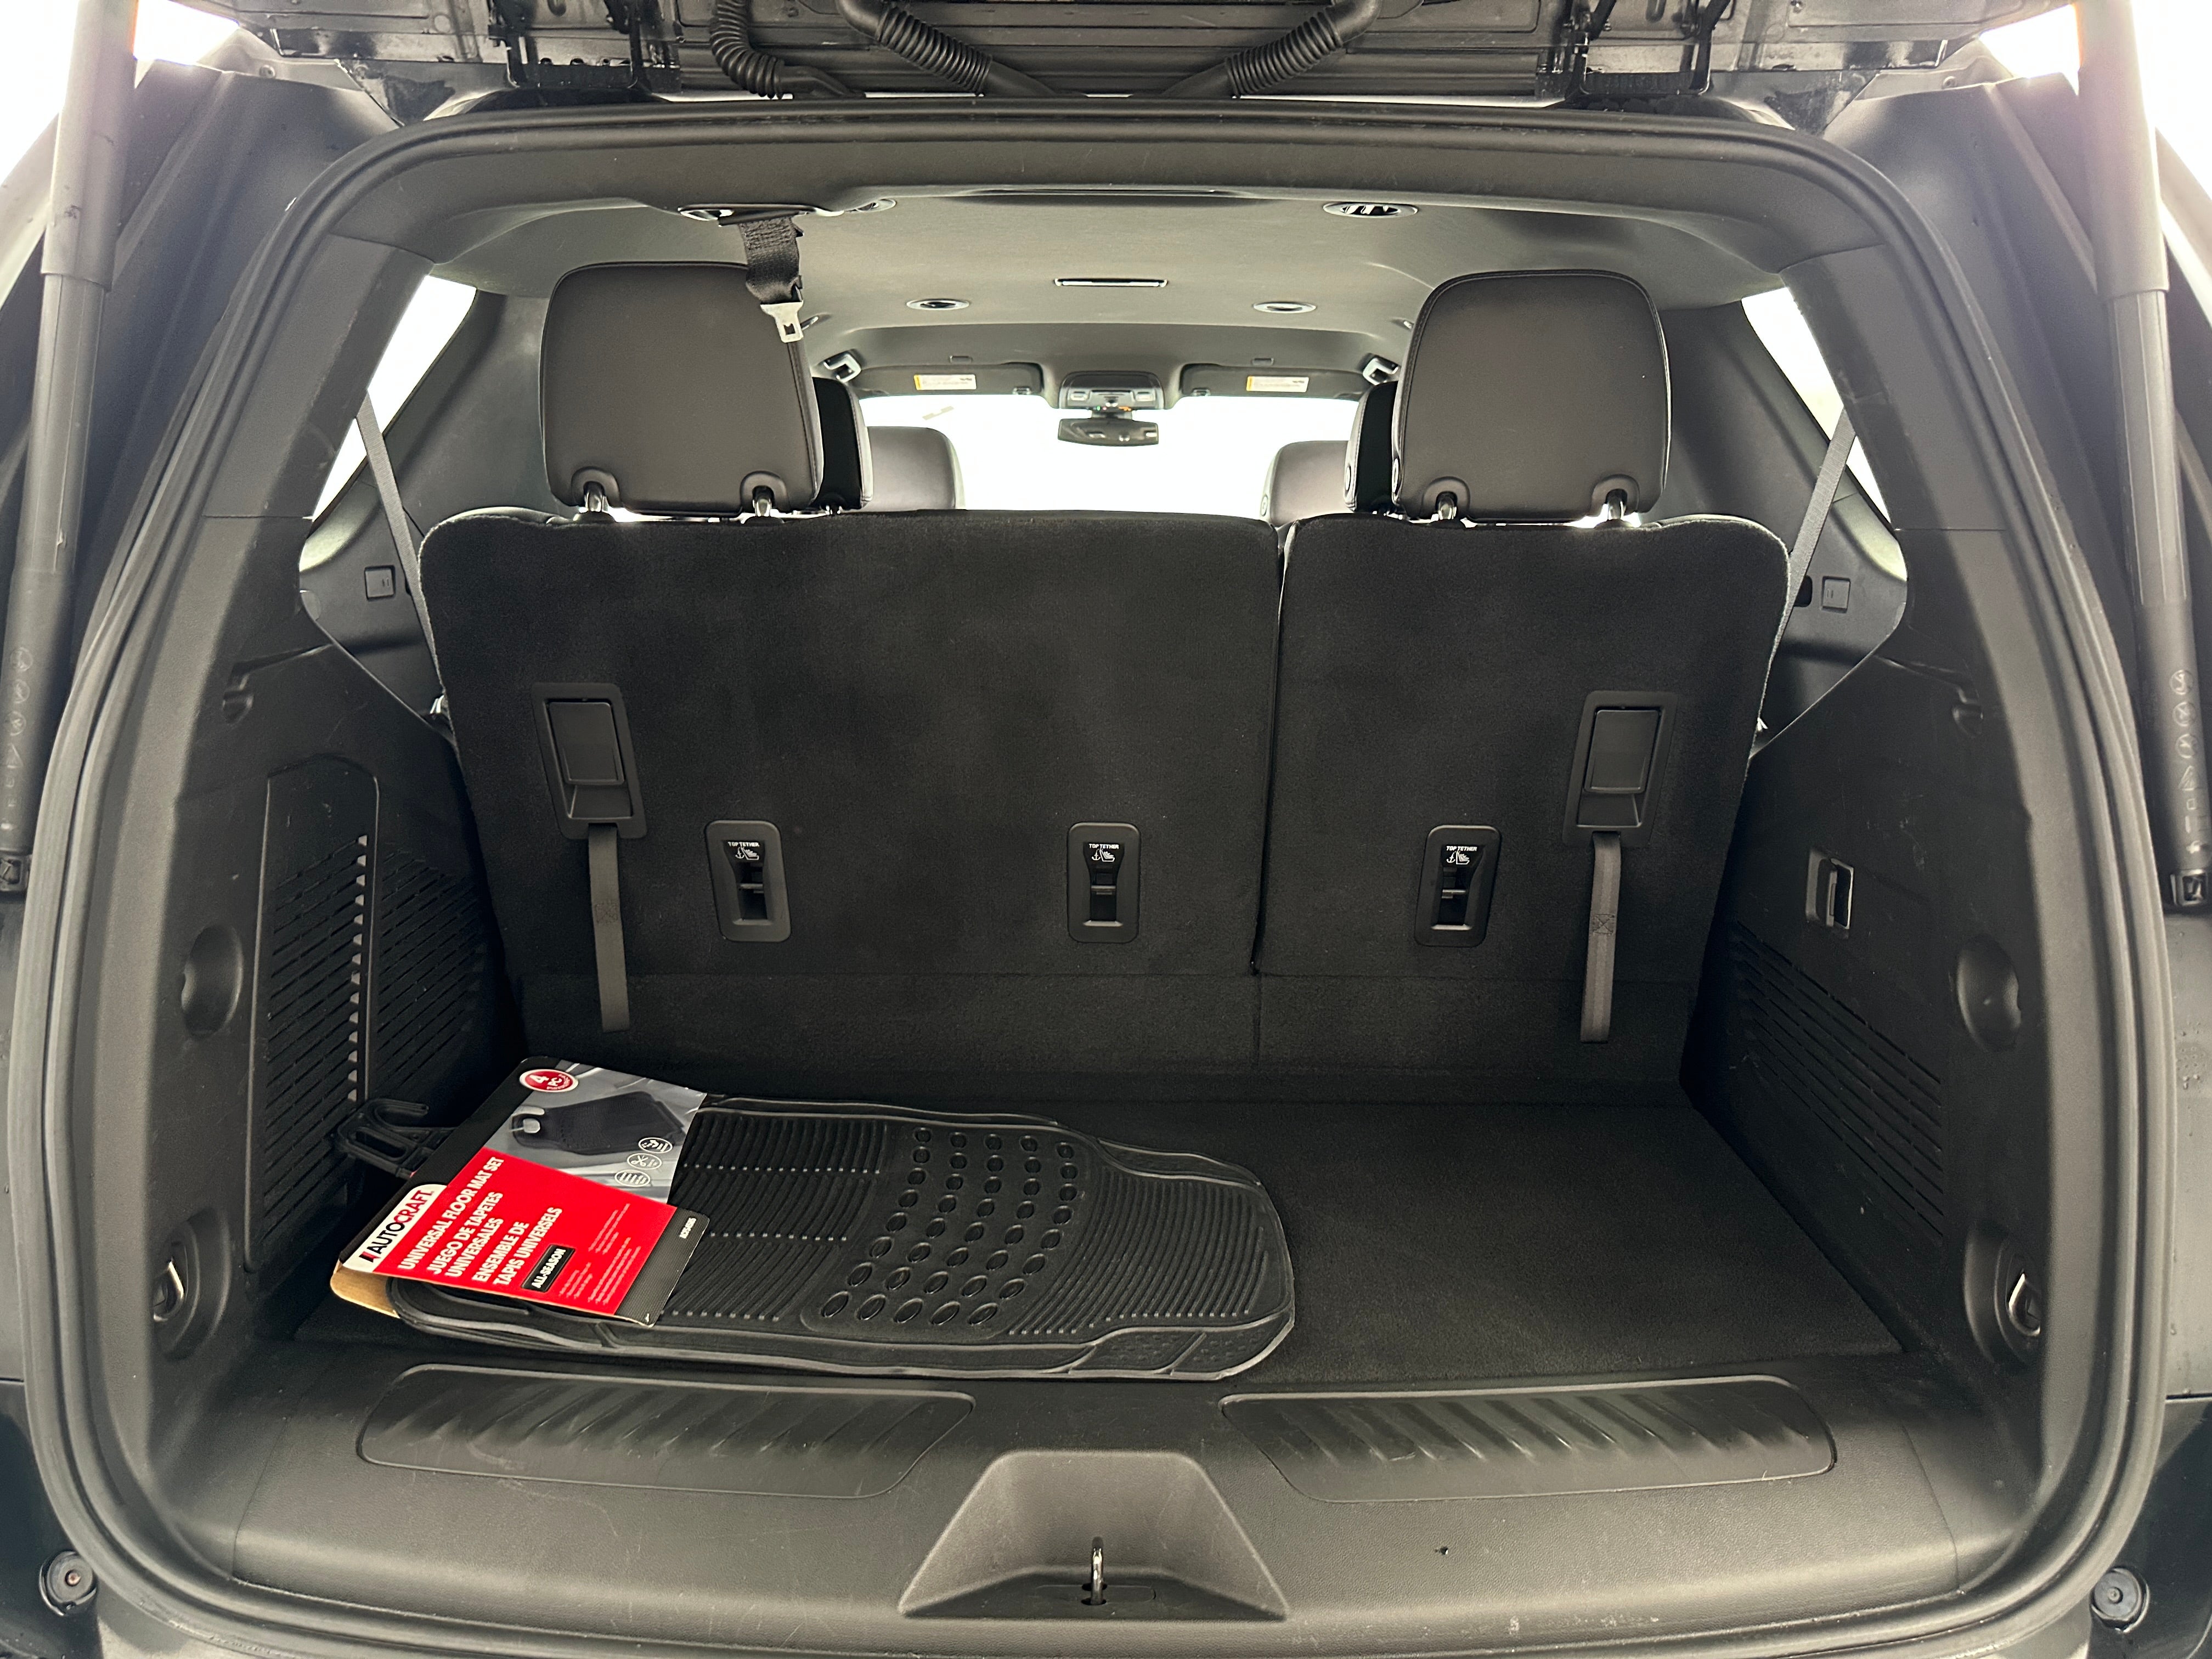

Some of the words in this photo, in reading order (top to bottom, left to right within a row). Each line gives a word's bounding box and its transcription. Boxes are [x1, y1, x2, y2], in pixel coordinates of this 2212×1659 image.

[529, 1075, 549, 1084] 4
[548, 1077, 562, 1086] PC
[366, 1190, 433, 1254] AUTOCRAFT
[398, 1220, 453, 1269] UNIVERSAL
[441, 1189, 478, 1220] FLOOR
[467, 1170, 493, 1189] MAT
[483, 1156, 505, 1172] SET
[464, 1192, 504, 1226] TAPETES
[444, 1217, 504, 1277] UNIVERSALES
[453, 1227, 476, 1240] DE
[471, 1234, 520, 1282] ENSEMBLE
[508, 1221, 530, 1235] DE
[493, 1259, 525, 1285] TAPIS
[514, 1207, 563, 1259] UNIVERSELS
[426, 1241, 463, 1274] JUEGO
[531, 1248, 567, 1289] ALL-SEASON
